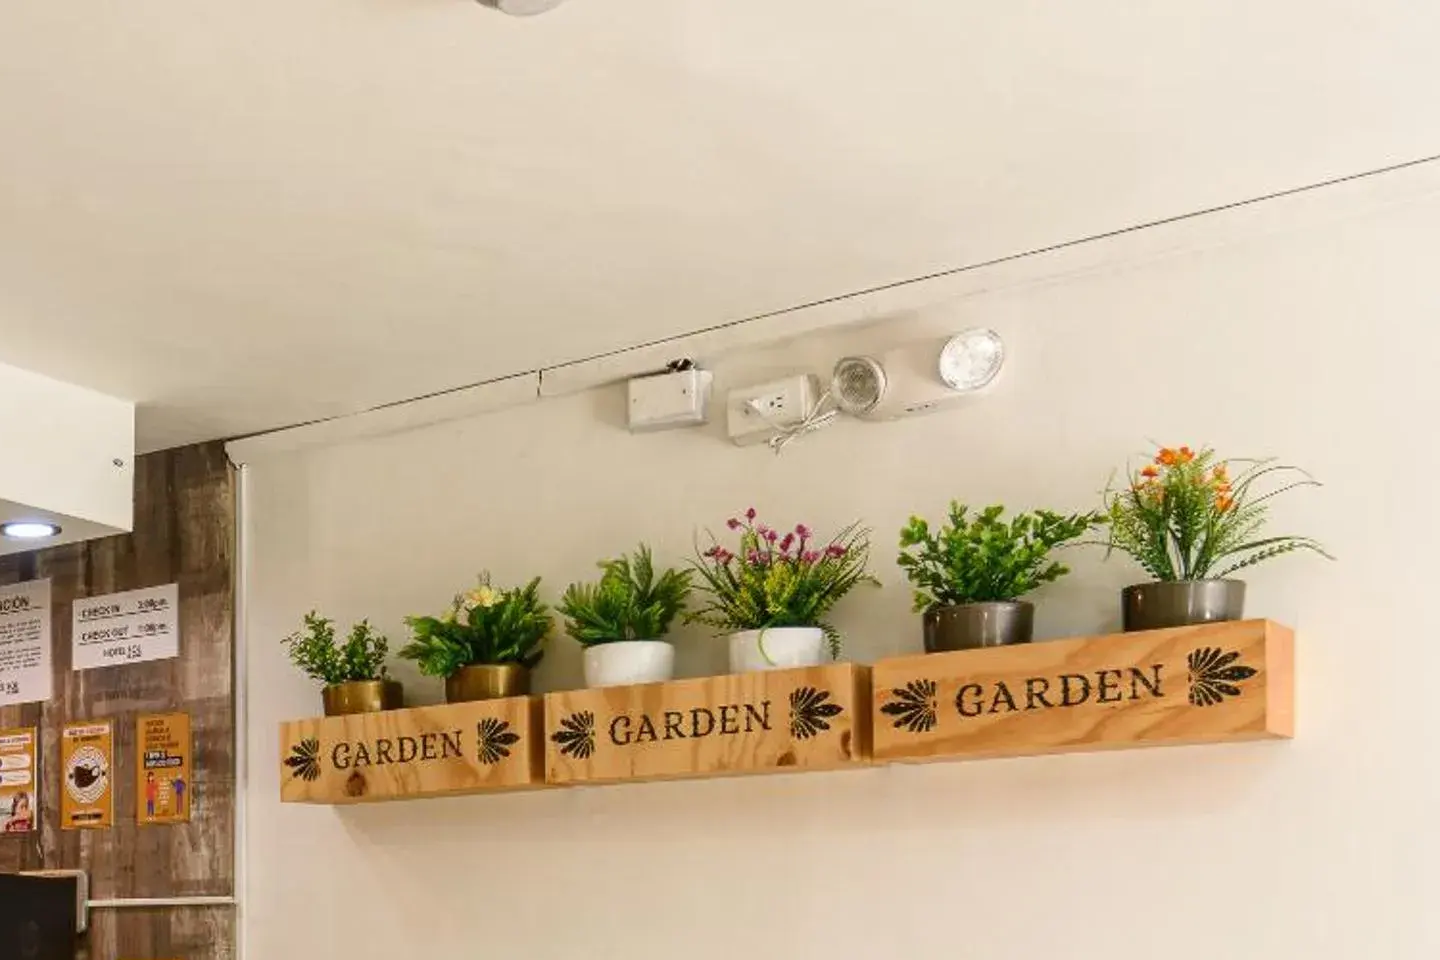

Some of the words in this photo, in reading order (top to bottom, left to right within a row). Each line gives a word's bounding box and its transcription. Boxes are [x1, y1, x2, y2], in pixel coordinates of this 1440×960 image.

[954, 663, 1165, 718] GARDEN
[607, 702, 772, 746] GARDEN
[331, 730, 463, 770] GARDEN
